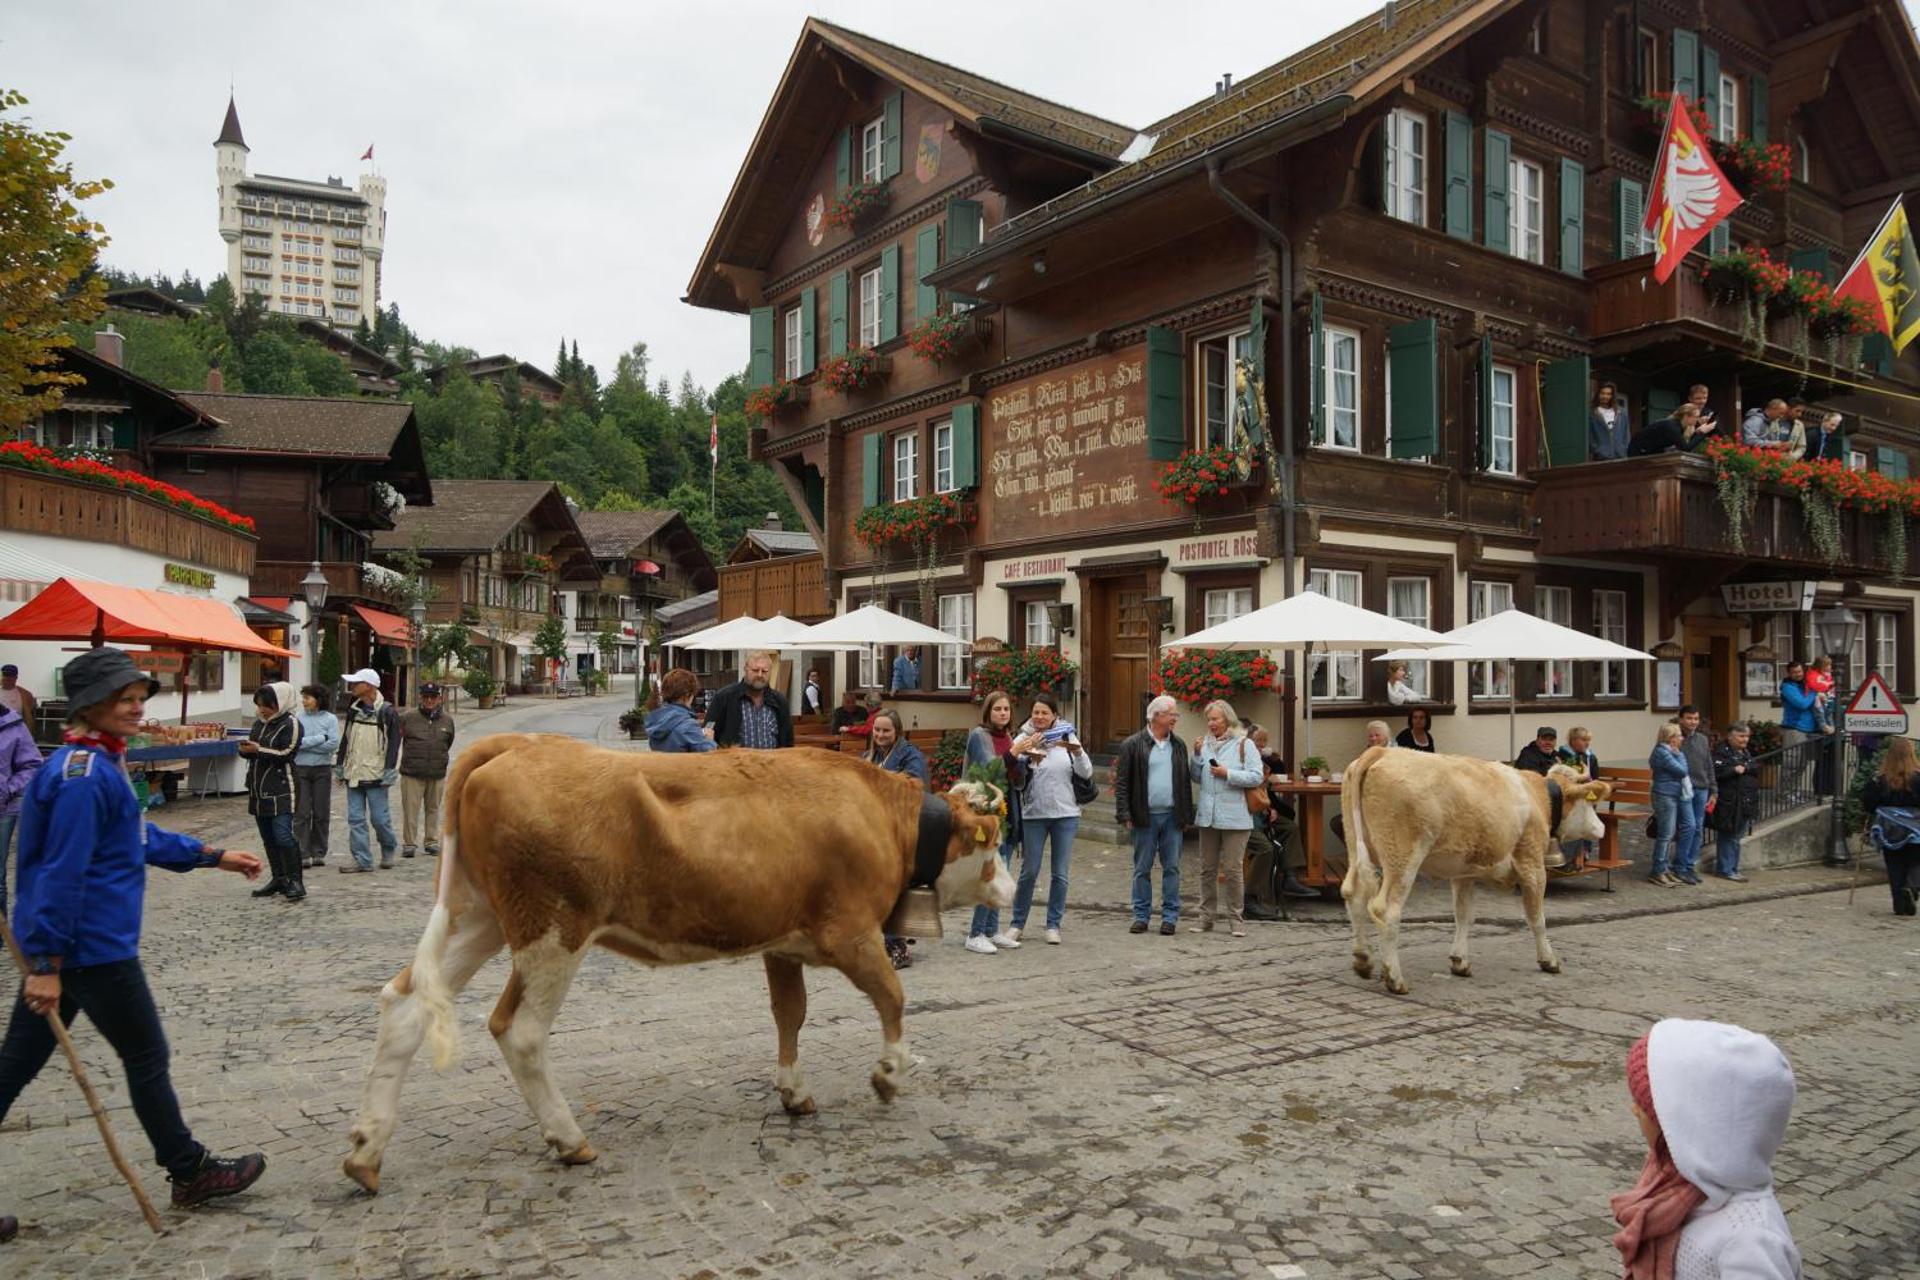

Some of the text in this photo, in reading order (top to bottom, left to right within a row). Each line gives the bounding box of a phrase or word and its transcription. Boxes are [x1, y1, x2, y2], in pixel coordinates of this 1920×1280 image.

[1179, 539, 1229, 561] POSTHOTEL
[1023, 557, 1066, 577] RESTAURANT
[1729, 580, 1793, 601] Hotel
[1847, 717, 1903, 728] Senksäulen
